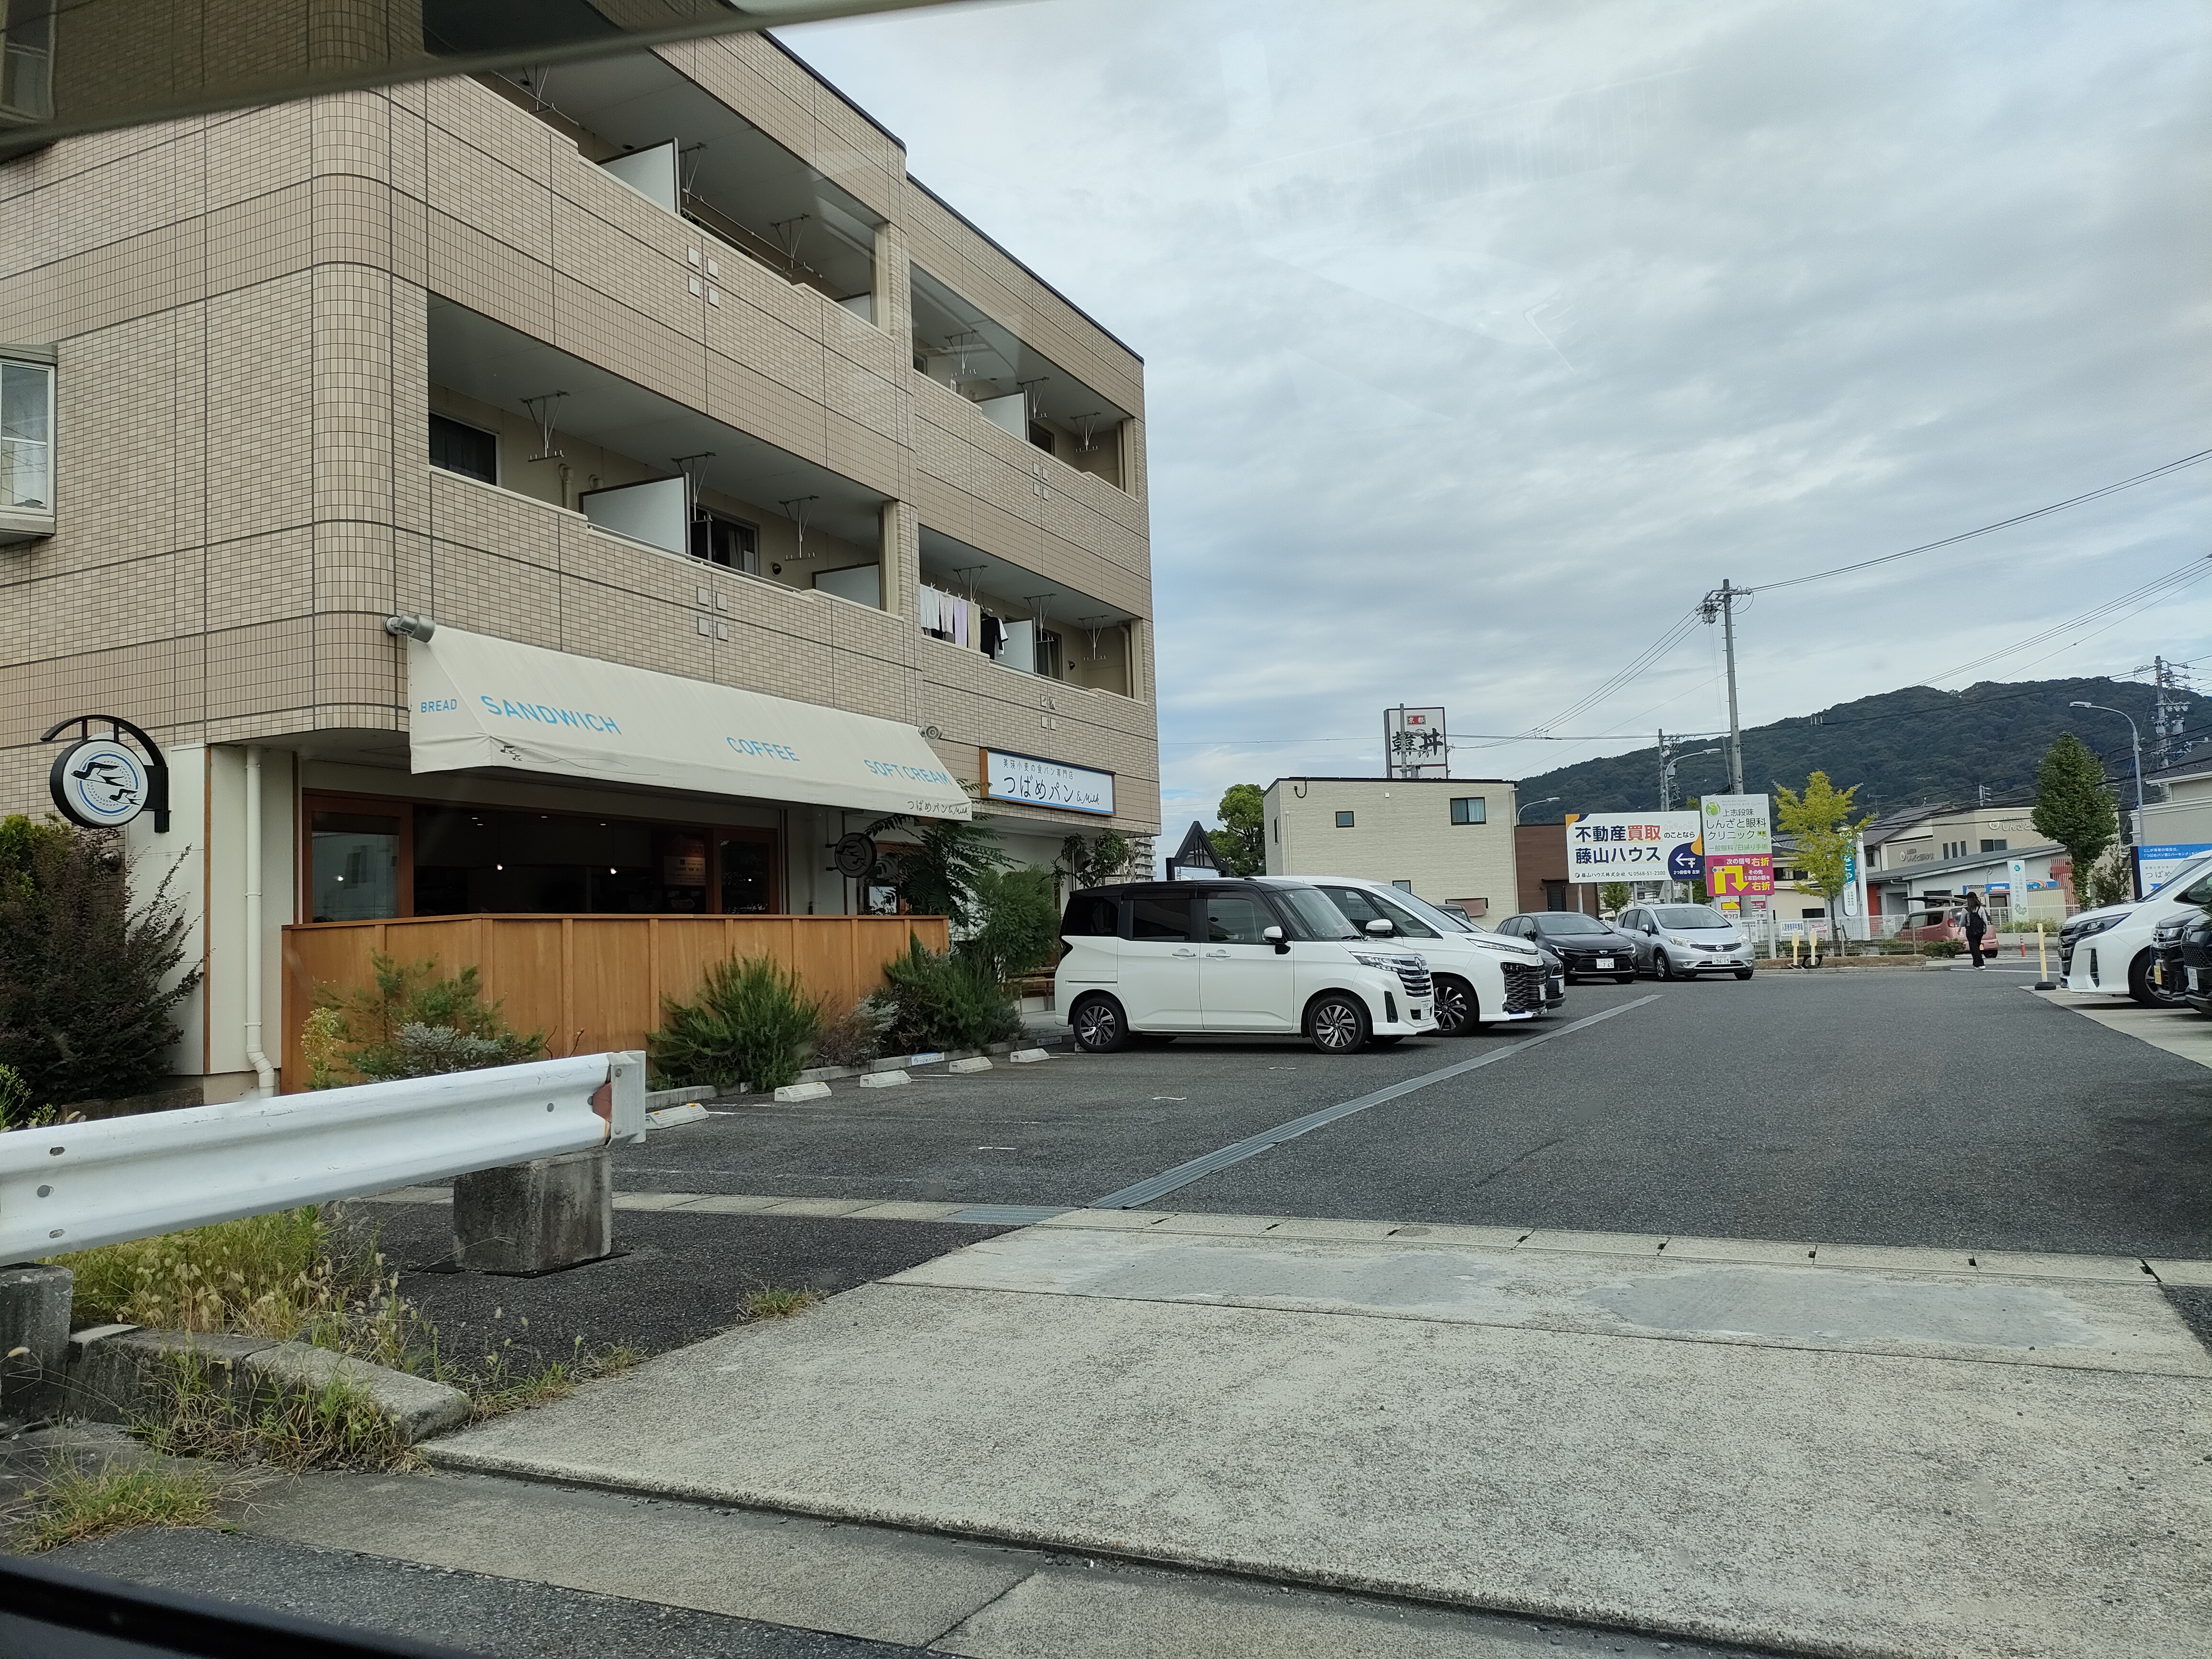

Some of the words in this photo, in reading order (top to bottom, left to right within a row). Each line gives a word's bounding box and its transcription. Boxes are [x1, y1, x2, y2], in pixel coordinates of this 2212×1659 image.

[421, 698, 457, 713] BREAD
[480, 696, 622, 735] SANDWICH
[726, 737, 800, 762] COFFEE
[864, 759, 904, 779] SOFT
[904, 766, 952, 785] CREAM
[1003, 758, 1073, 780] 美瑛小麦の食パン専門店
[1004, 774, 1074, 803] つばめパン
[1081, 792, 1100, 805] Milk
[907, 800, 947, 813] つばめパン
[1723, 808, 1754, 817] 上志段味
[1706, 818, 1766, 829] しんざと眼科
[1575, 824, 1661, 842] 不動産買取
[1708, 830, 1755, 840] クリニック
[1575, 847, 1661, 864] 藤山ハウス
[1751, 857, 1770, 866] 右折
[1752, 882, 1770, 891] 右折
